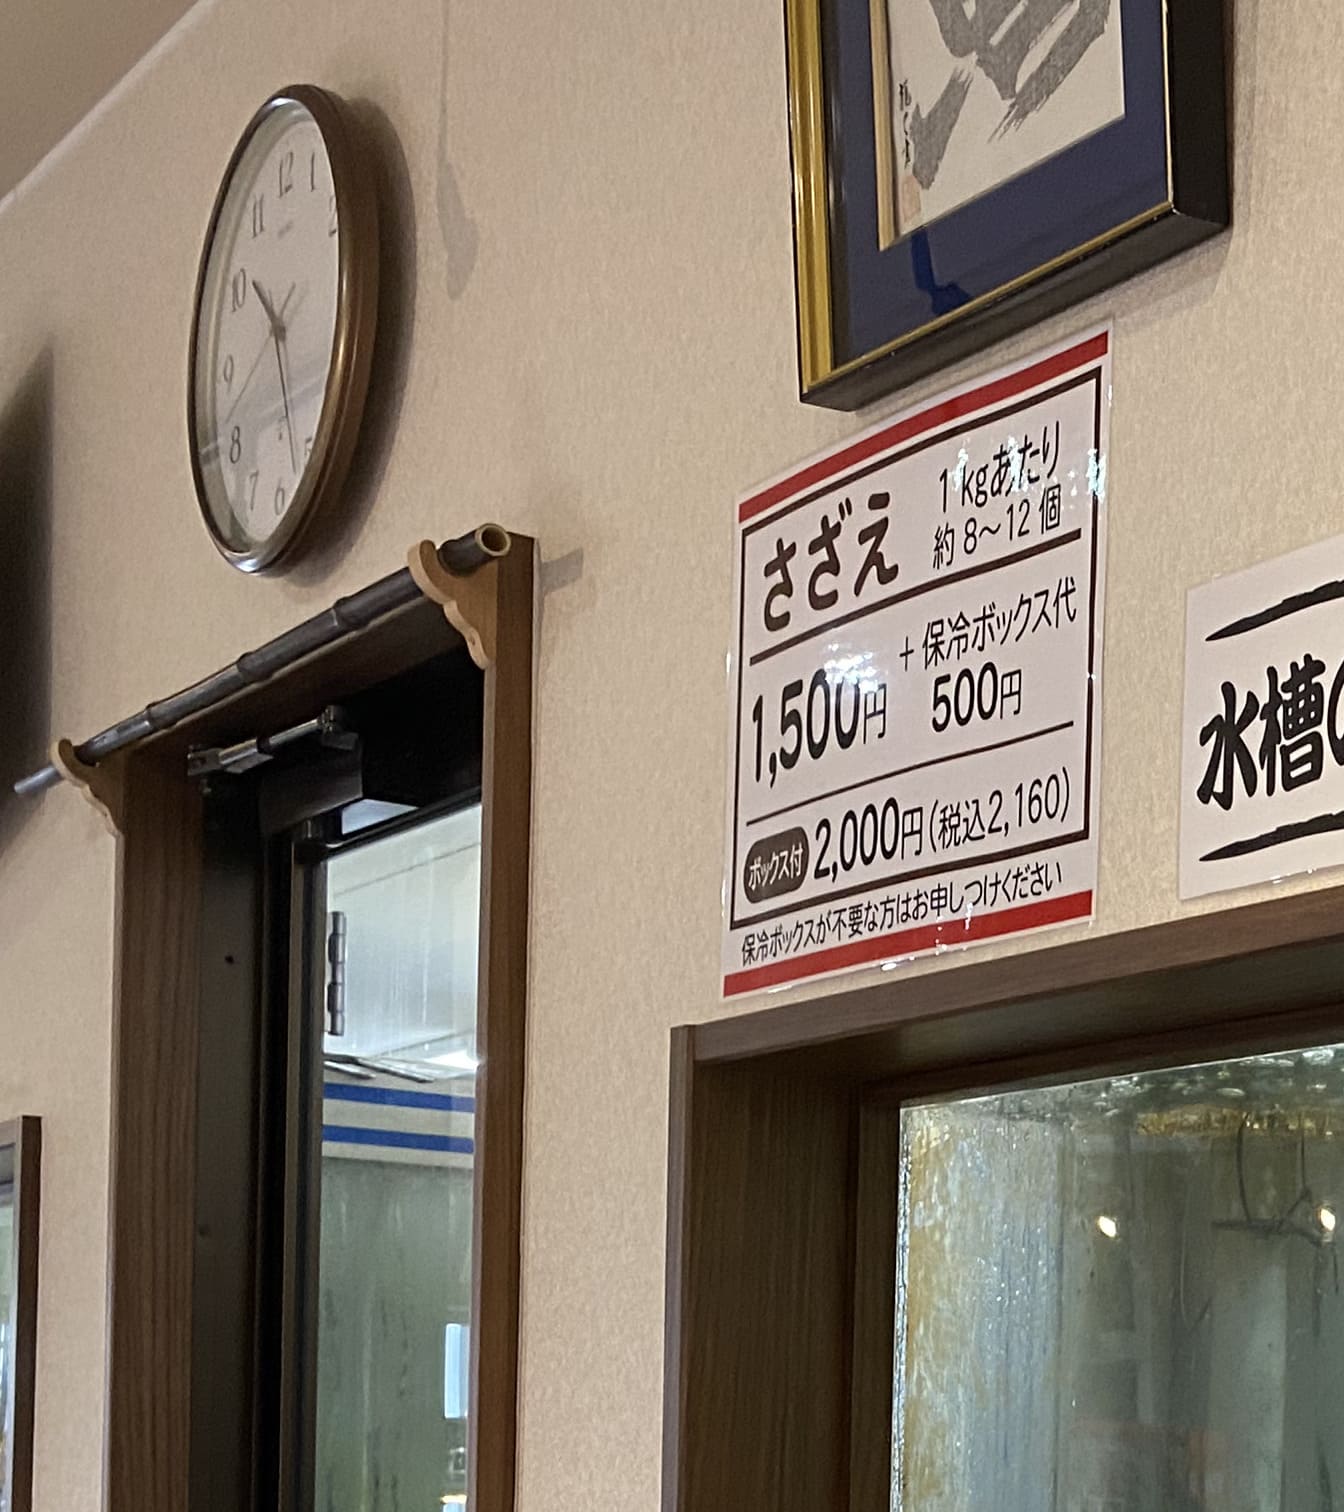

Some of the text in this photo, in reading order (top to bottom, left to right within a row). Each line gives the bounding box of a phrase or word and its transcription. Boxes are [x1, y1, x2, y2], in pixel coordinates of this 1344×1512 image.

[277, 151, 294, 199] 12
[230, 268, 247, 313] 10
[223, 354, 235, 385] 9
[229, 426, 243, 465] 8
[248, 471, 260, 513] 7
[273, 483, 285, 517] 6
[761, 491, 899, 633] さざえ
[931, 660, 1022, 735] 500円
[750, 668, 887, 785] 1,500円
[747, 839, 805, 892] ボックス付
[741, 859, 1063, 967] 保冷ボックスが不要な方はお申しつけください
